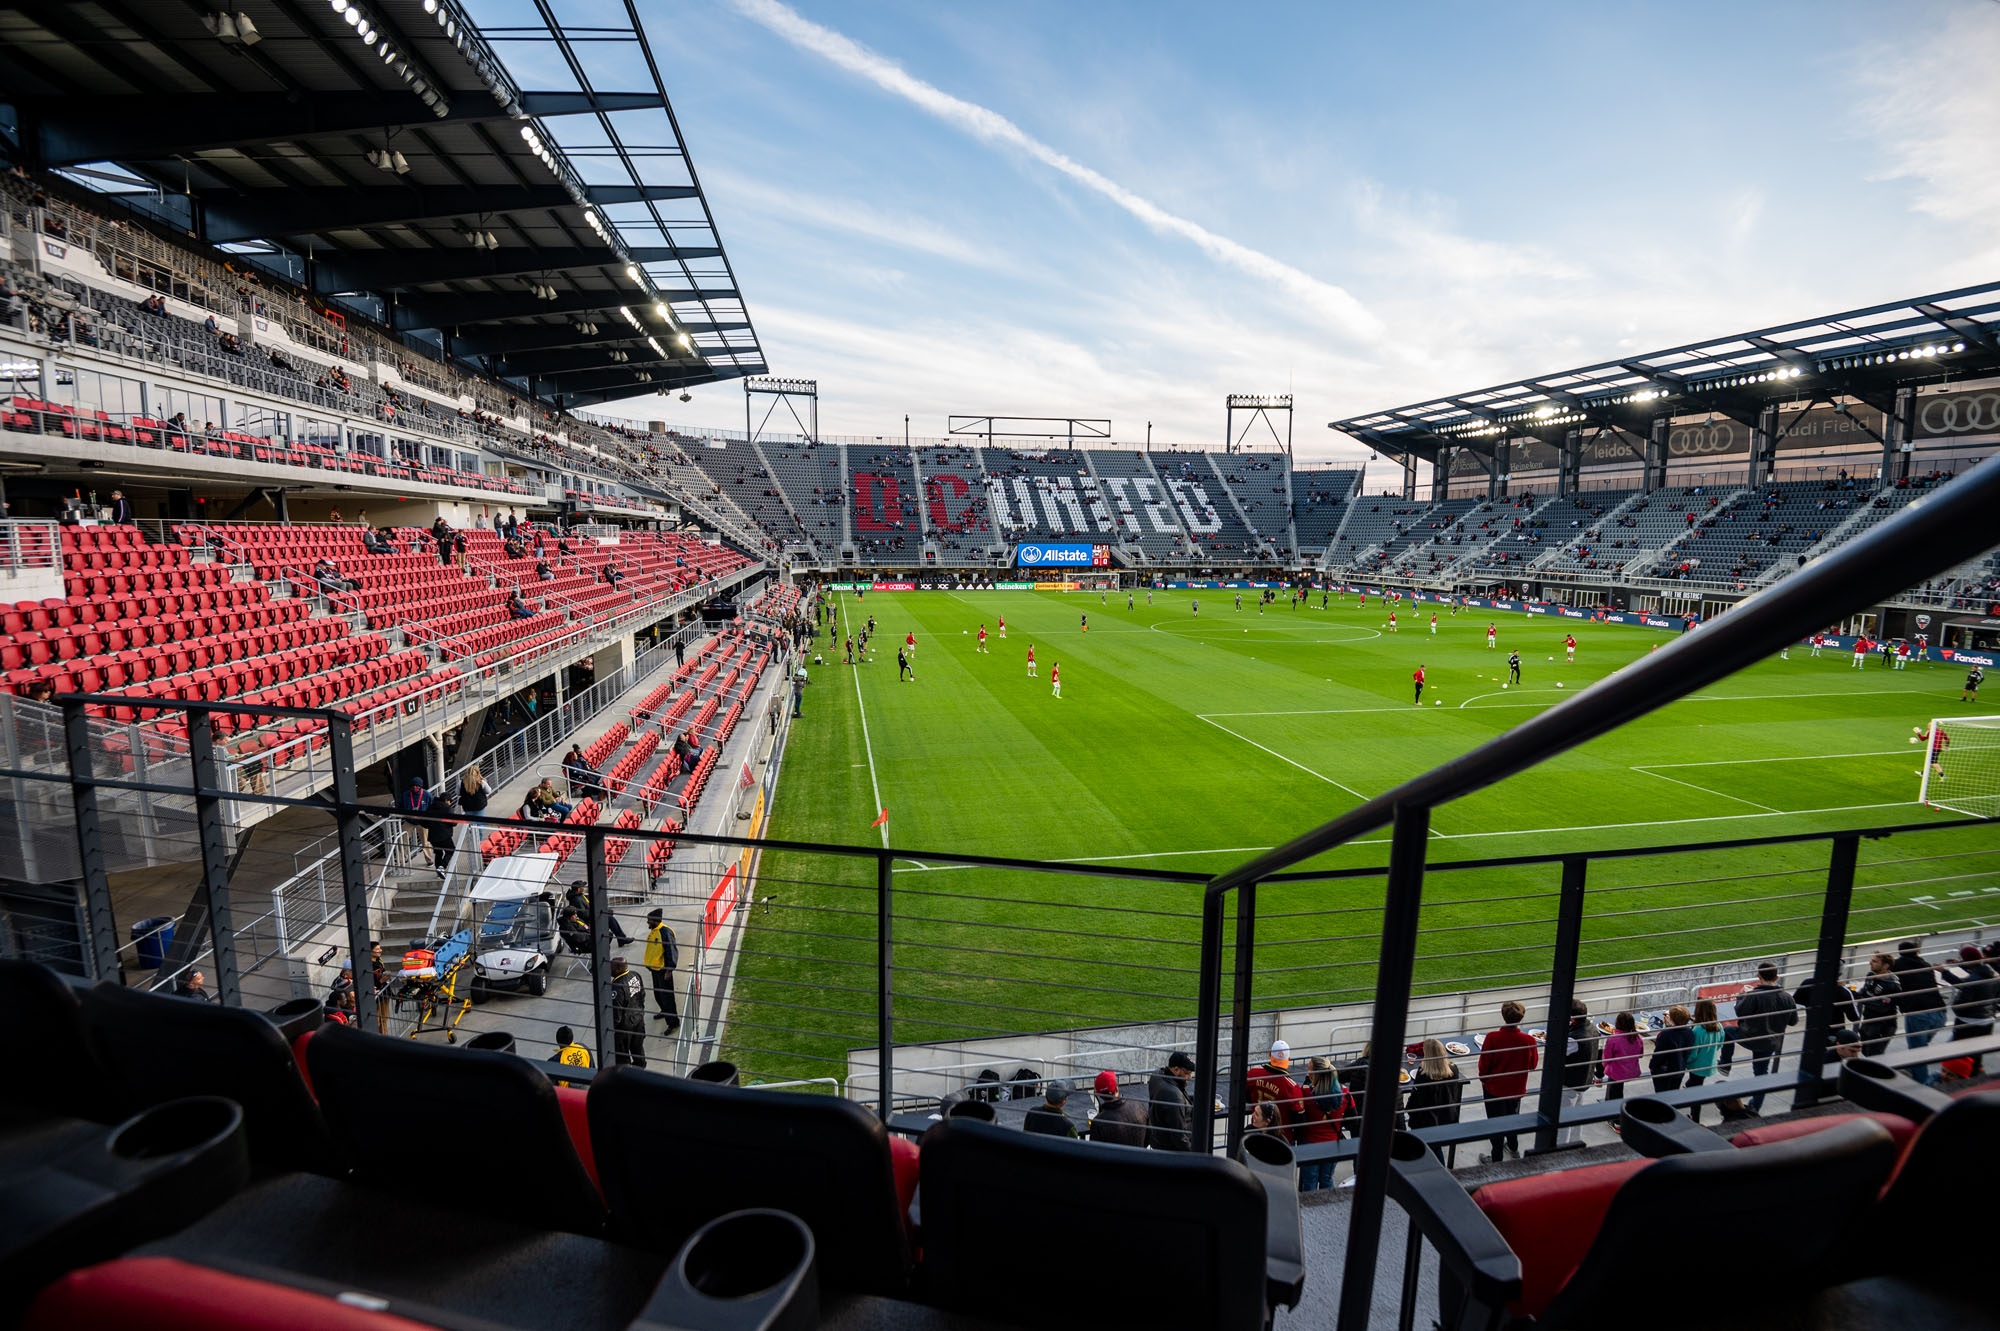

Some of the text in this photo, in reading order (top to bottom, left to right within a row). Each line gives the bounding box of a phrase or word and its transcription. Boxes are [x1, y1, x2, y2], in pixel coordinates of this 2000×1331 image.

[1776, 416, 1870, 438] Audi Field
[1594, 443, 1633, 459] leidos
[1510, 460, 1545, 472] Heineken
[990, 476, 1222, 533] UNITED
[831, 583, 865, 591] Heineen
[1647, 618, 1669, 627] Fanatics
[1954, 652, 1993, 665] Fanatics
[1255, 1079, 1280, 1095] ATLANTA
